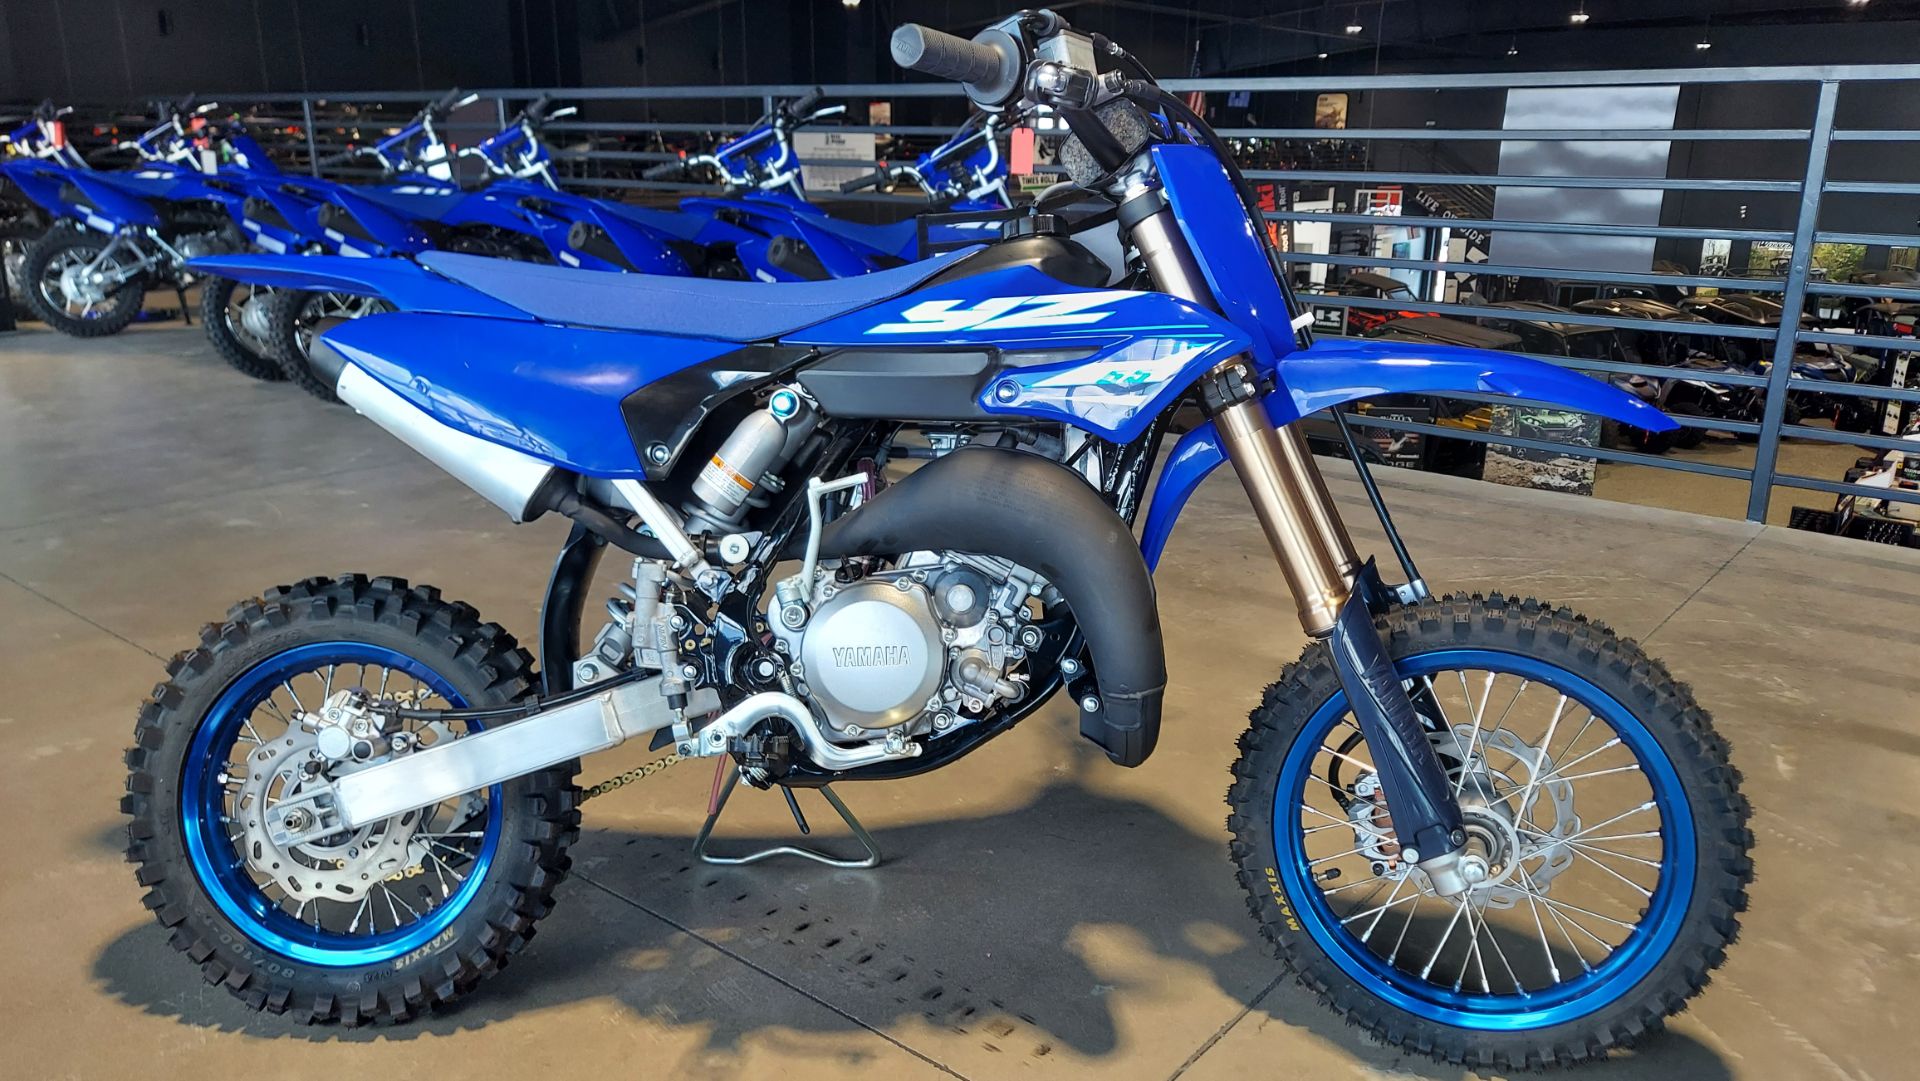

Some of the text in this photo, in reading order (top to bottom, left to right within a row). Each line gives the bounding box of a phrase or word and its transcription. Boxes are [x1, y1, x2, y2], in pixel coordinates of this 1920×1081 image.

[1041, 175, 1055, 183] ROLL
[1415, 190, 1440, 212] LIVE
[863, 290, 1153, 335] YZ
[832, 645, 912, 667] YAMAHA
[1361, 653, 1427, 767] YAMAHA
[1264, 866, 1301, 932] MAXXIS
[394, 926, 455, 971] MAXXIS
